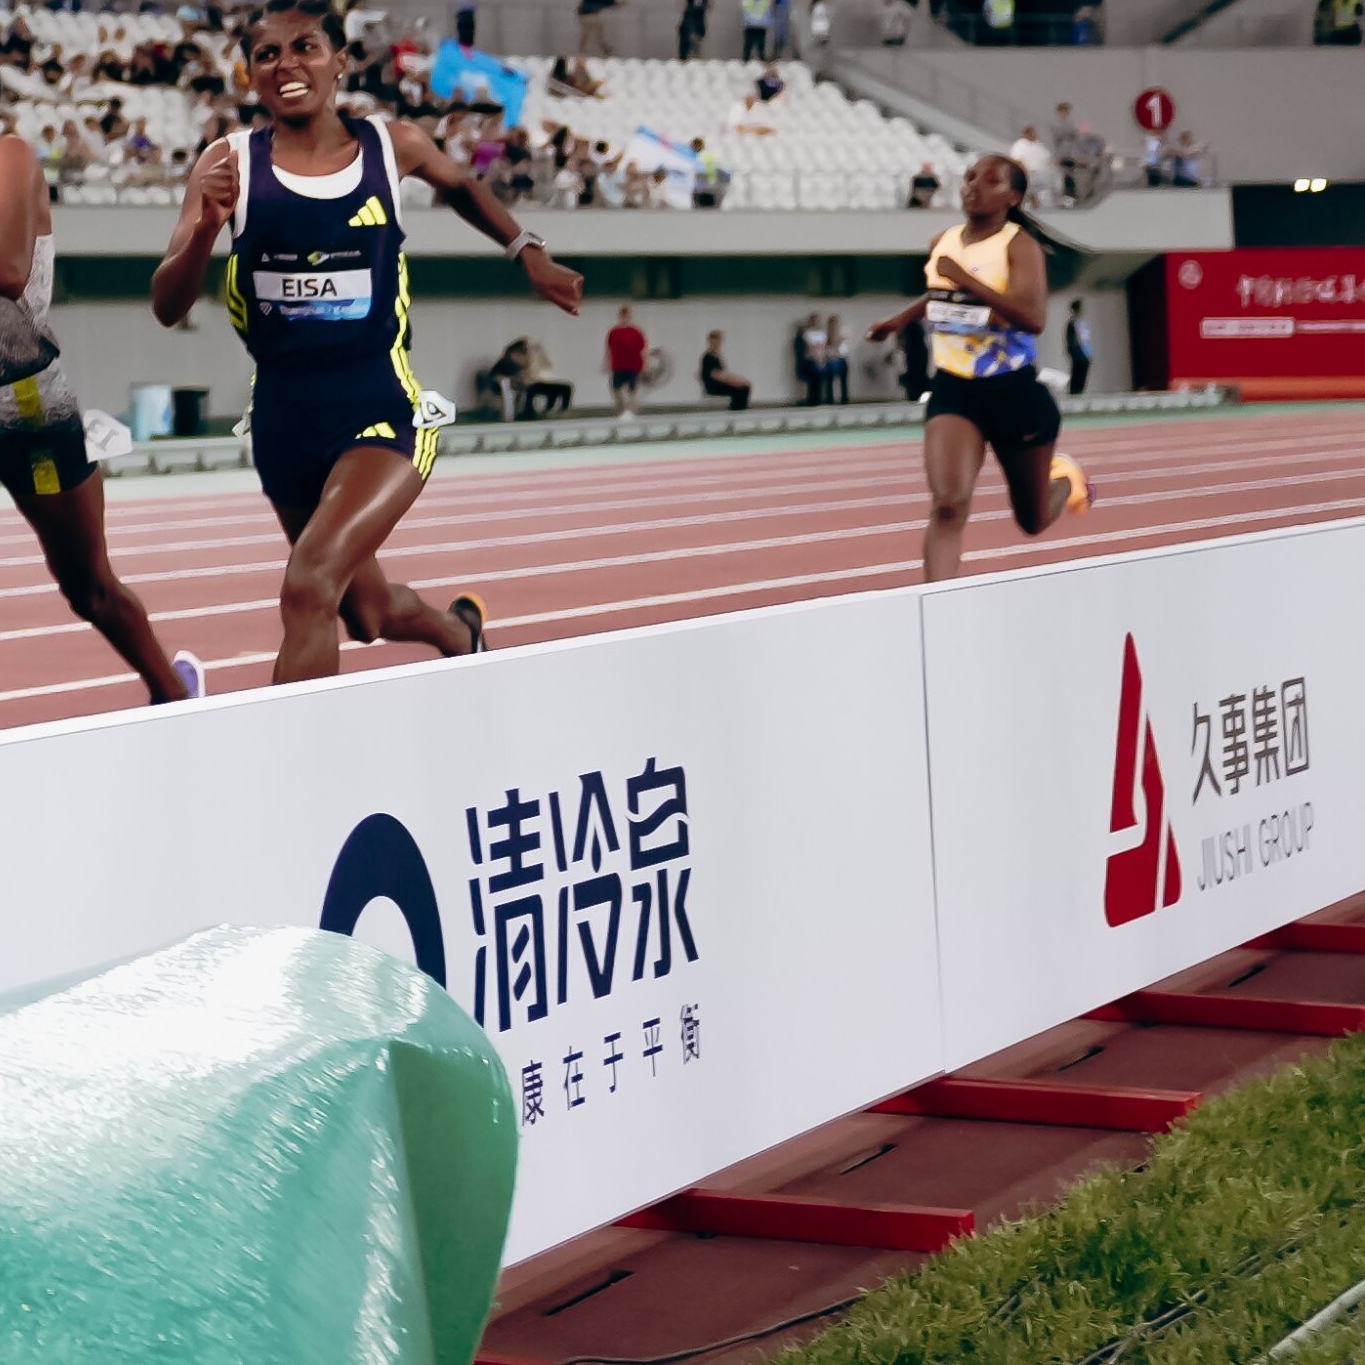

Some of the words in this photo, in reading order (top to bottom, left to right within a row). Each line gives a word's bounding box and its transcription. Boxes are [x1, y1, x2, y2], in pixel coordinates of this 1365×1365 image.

[1145, 93, 1162, 129] 1
[282, 278, 338, 297] EISA
[1191, 677, 1309, 806] 久事集团
[465, 756, 700, 1033] 清冷泉
[1197, 823, 1253, 891] JIUSHI
[1258, 801, 1315, 867] GROUP
[520, 1002, 701, 1126] 康在于平衡
